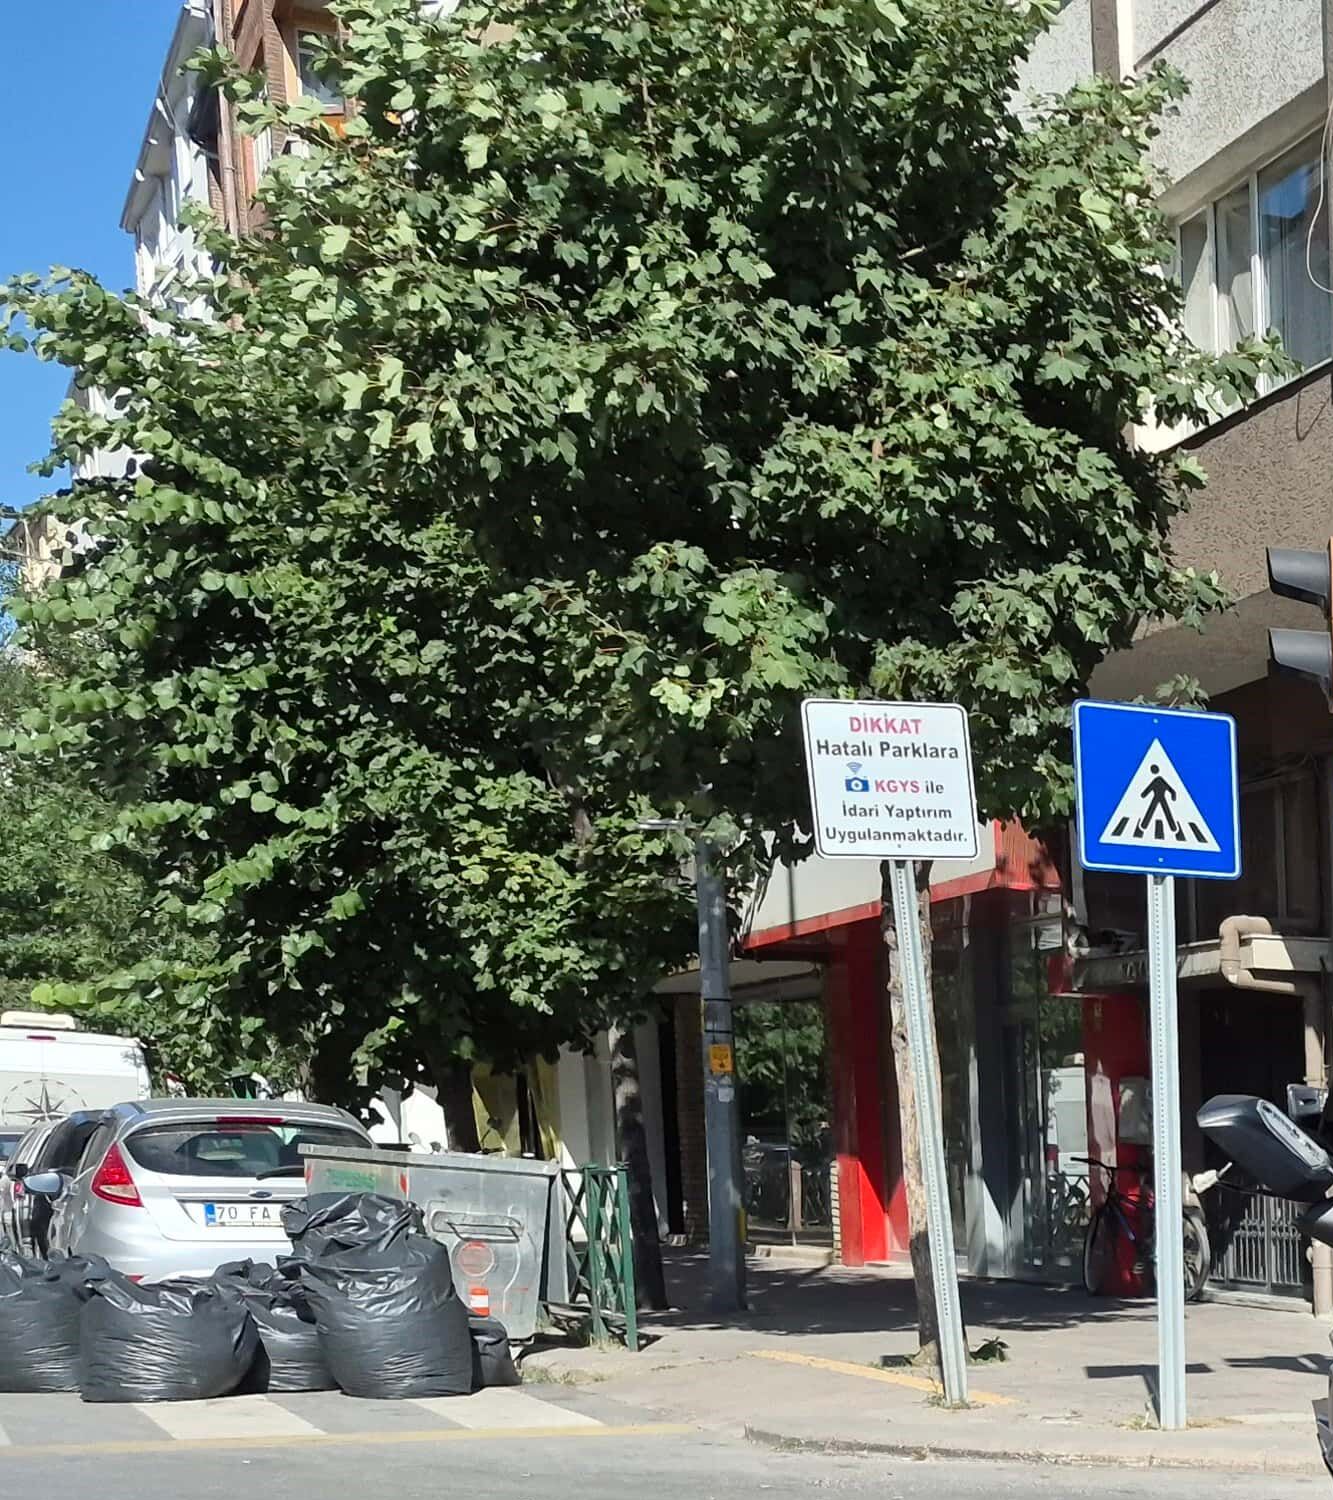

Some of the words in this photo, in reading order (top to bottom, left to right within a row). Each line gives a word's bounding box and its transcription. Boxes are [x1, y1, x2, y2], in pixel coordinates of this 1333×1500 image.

[849, 712, 922, 735] DİKKAT
[816, 739, 873, 757] Hatalı
[879, 741, 959, 759] Parklara
[874, 780, 921, 794] KGYS
[925, 780, 945, 794] ile
[842, 800, 880, 818] İdari
[885, 805, 952, 821] Yaptırım
[825, 827, 968, 843] Uygulanmaktadır.
[218, 1206, 238, 1220] 70
